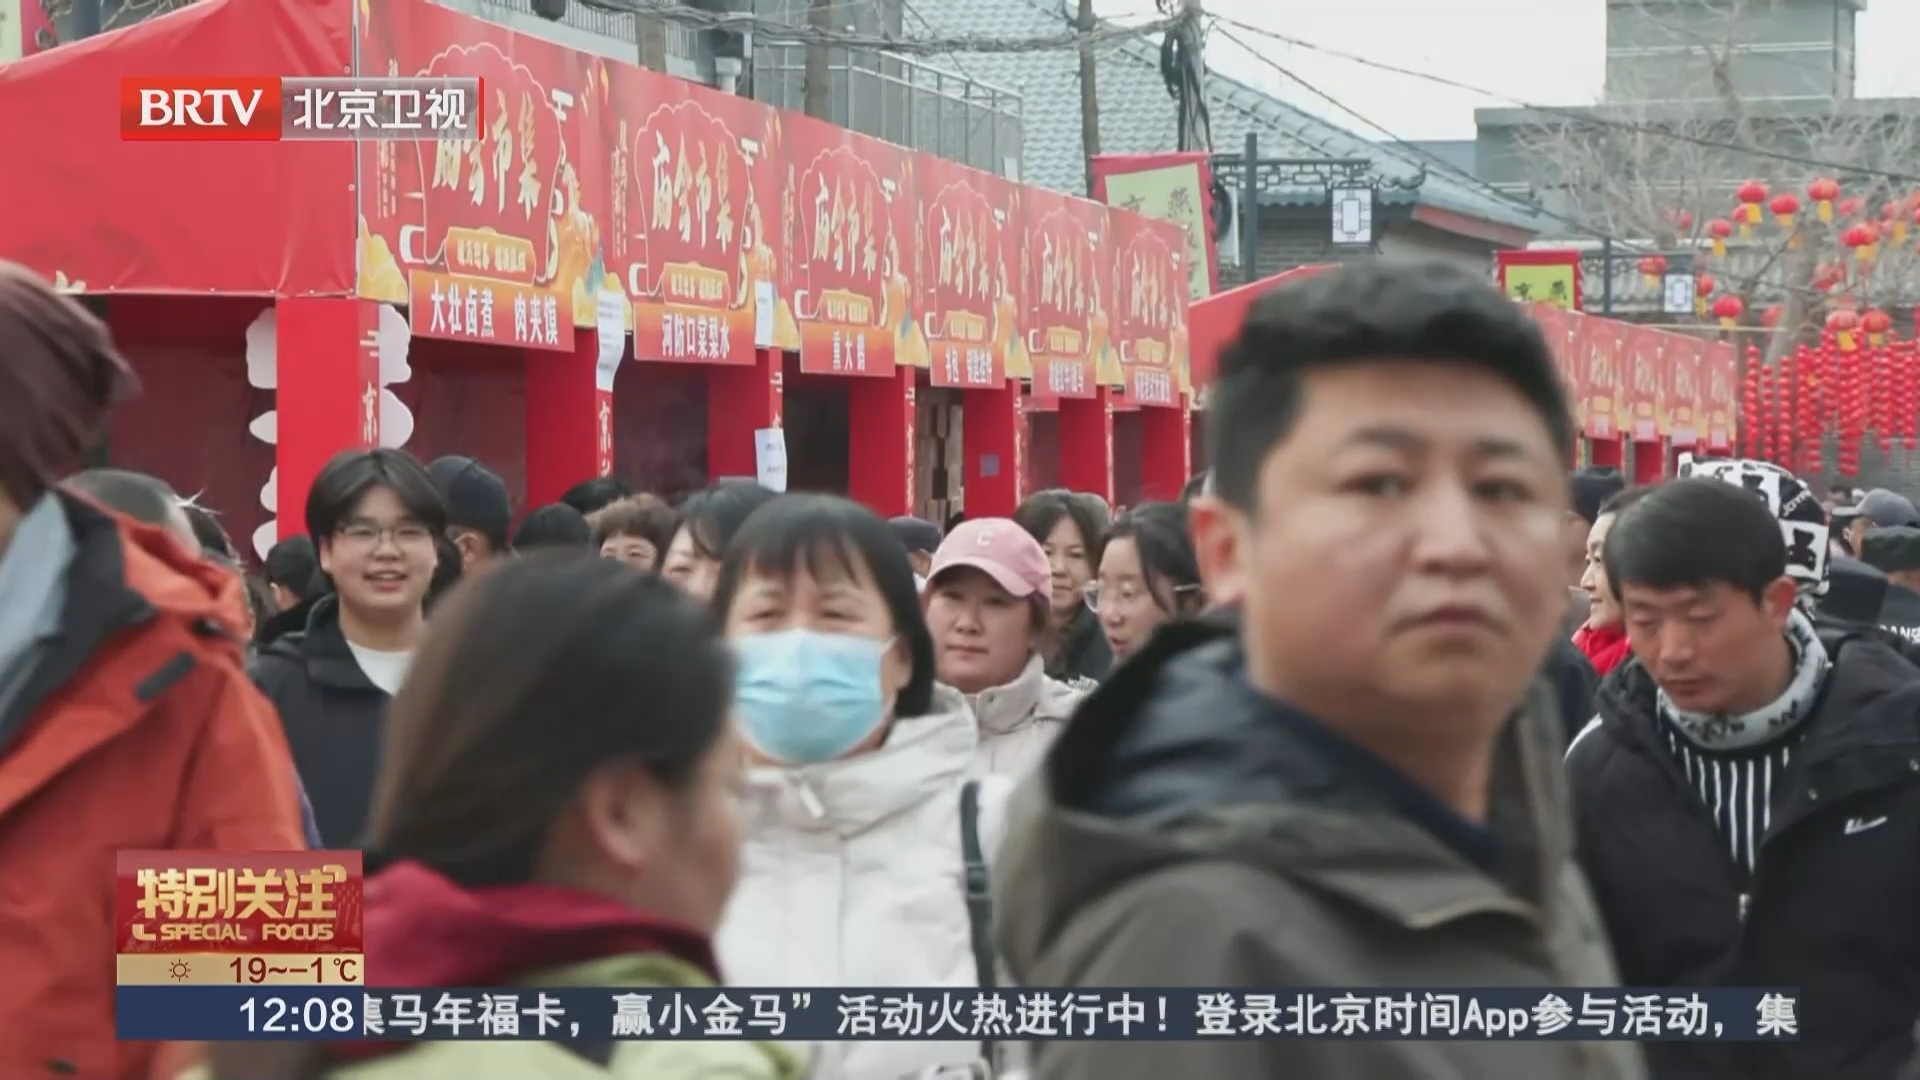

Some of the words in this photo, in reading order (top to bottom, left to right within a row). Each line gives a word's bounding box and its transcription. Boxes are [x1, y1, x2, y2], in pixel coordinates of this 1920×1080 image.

[430, 279, 494, 337] 大壮卤煮
[514, 291, 558, 345] 肉夹馍
